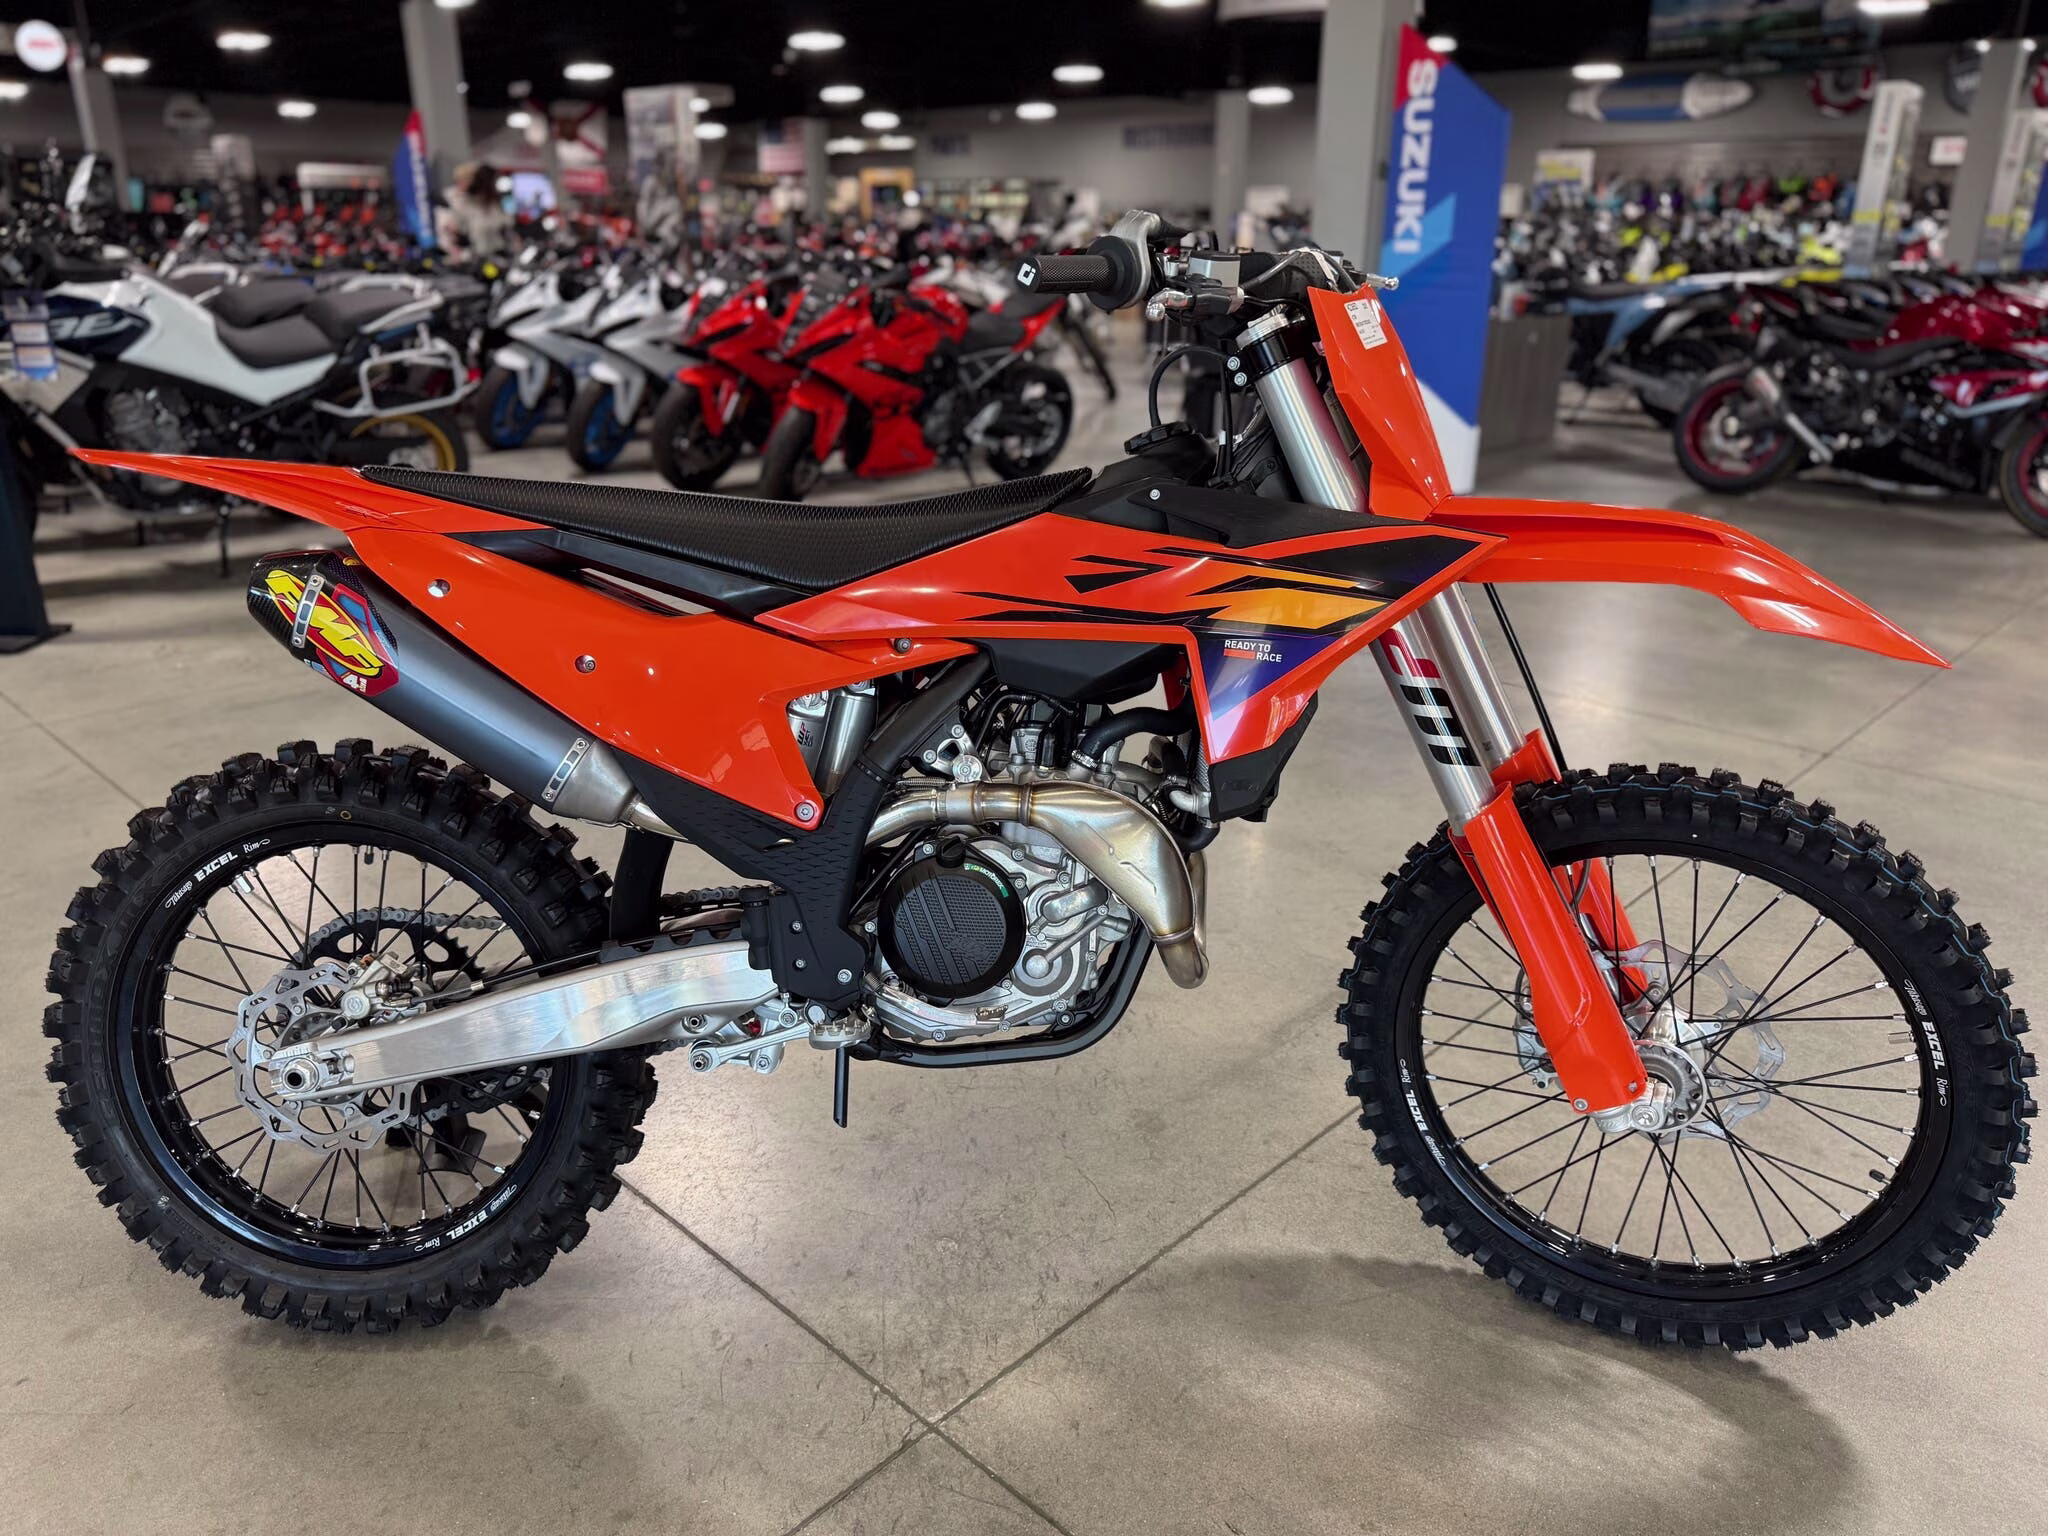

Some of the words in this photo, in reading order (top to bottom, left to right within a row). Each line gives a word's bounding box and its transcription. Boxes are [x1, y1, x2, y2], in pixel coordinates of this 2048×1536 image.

[1393, 58, 1439, 254] SUZUKI
[1224, 640, 1257, 651] READY
[1258, 643, 1271, 653] TO
[1256, 652, 1283, 663] RACE
[194, 851, 238, 882] EXCEL
[242, 839, 271, 854] Rim
[1400, 1058, 1412, 1084] Rim
[1921, 1021, 1946, 1070] EXCEL
[1936, 1077, 1948, 1107] Rim
[1405, 1089, 1429, 1132] EXCEL
[446, 1209, 488, 1240] EXCEL
[414, 1236, 441, 1252] Rim
